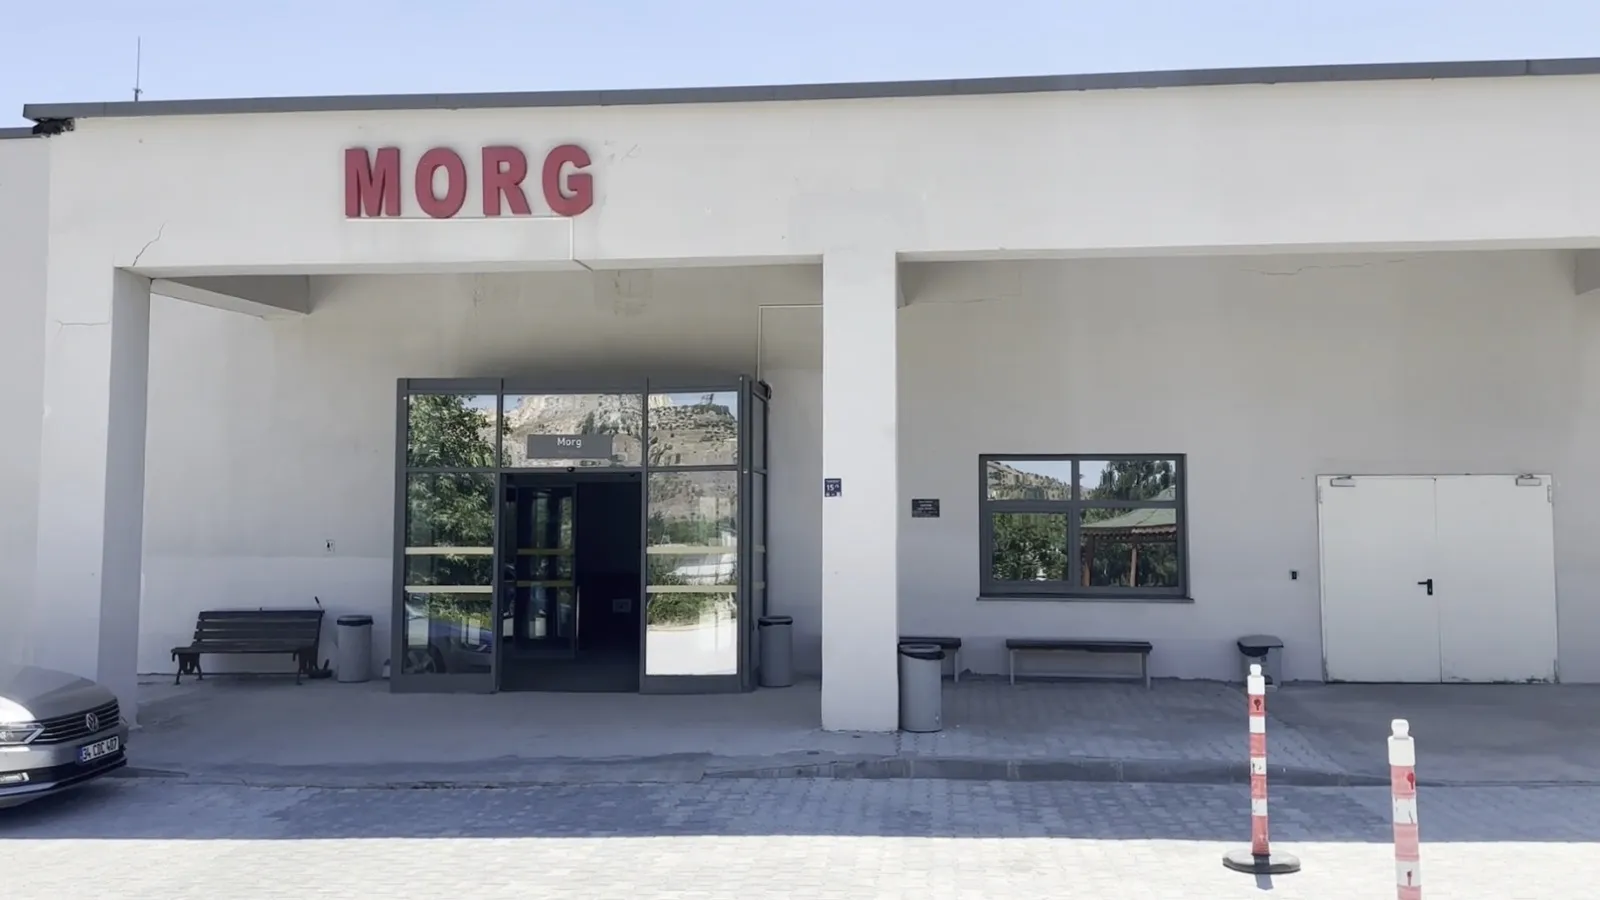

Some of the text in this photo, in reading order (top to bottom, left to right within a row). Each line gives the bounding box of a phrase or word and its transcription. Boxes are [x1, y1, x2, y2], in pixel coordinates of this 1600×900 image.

[344, 144, 593, 219] MORG
[556, 437, 582, 448] Morg
[82, 747, 92, 760] 34
